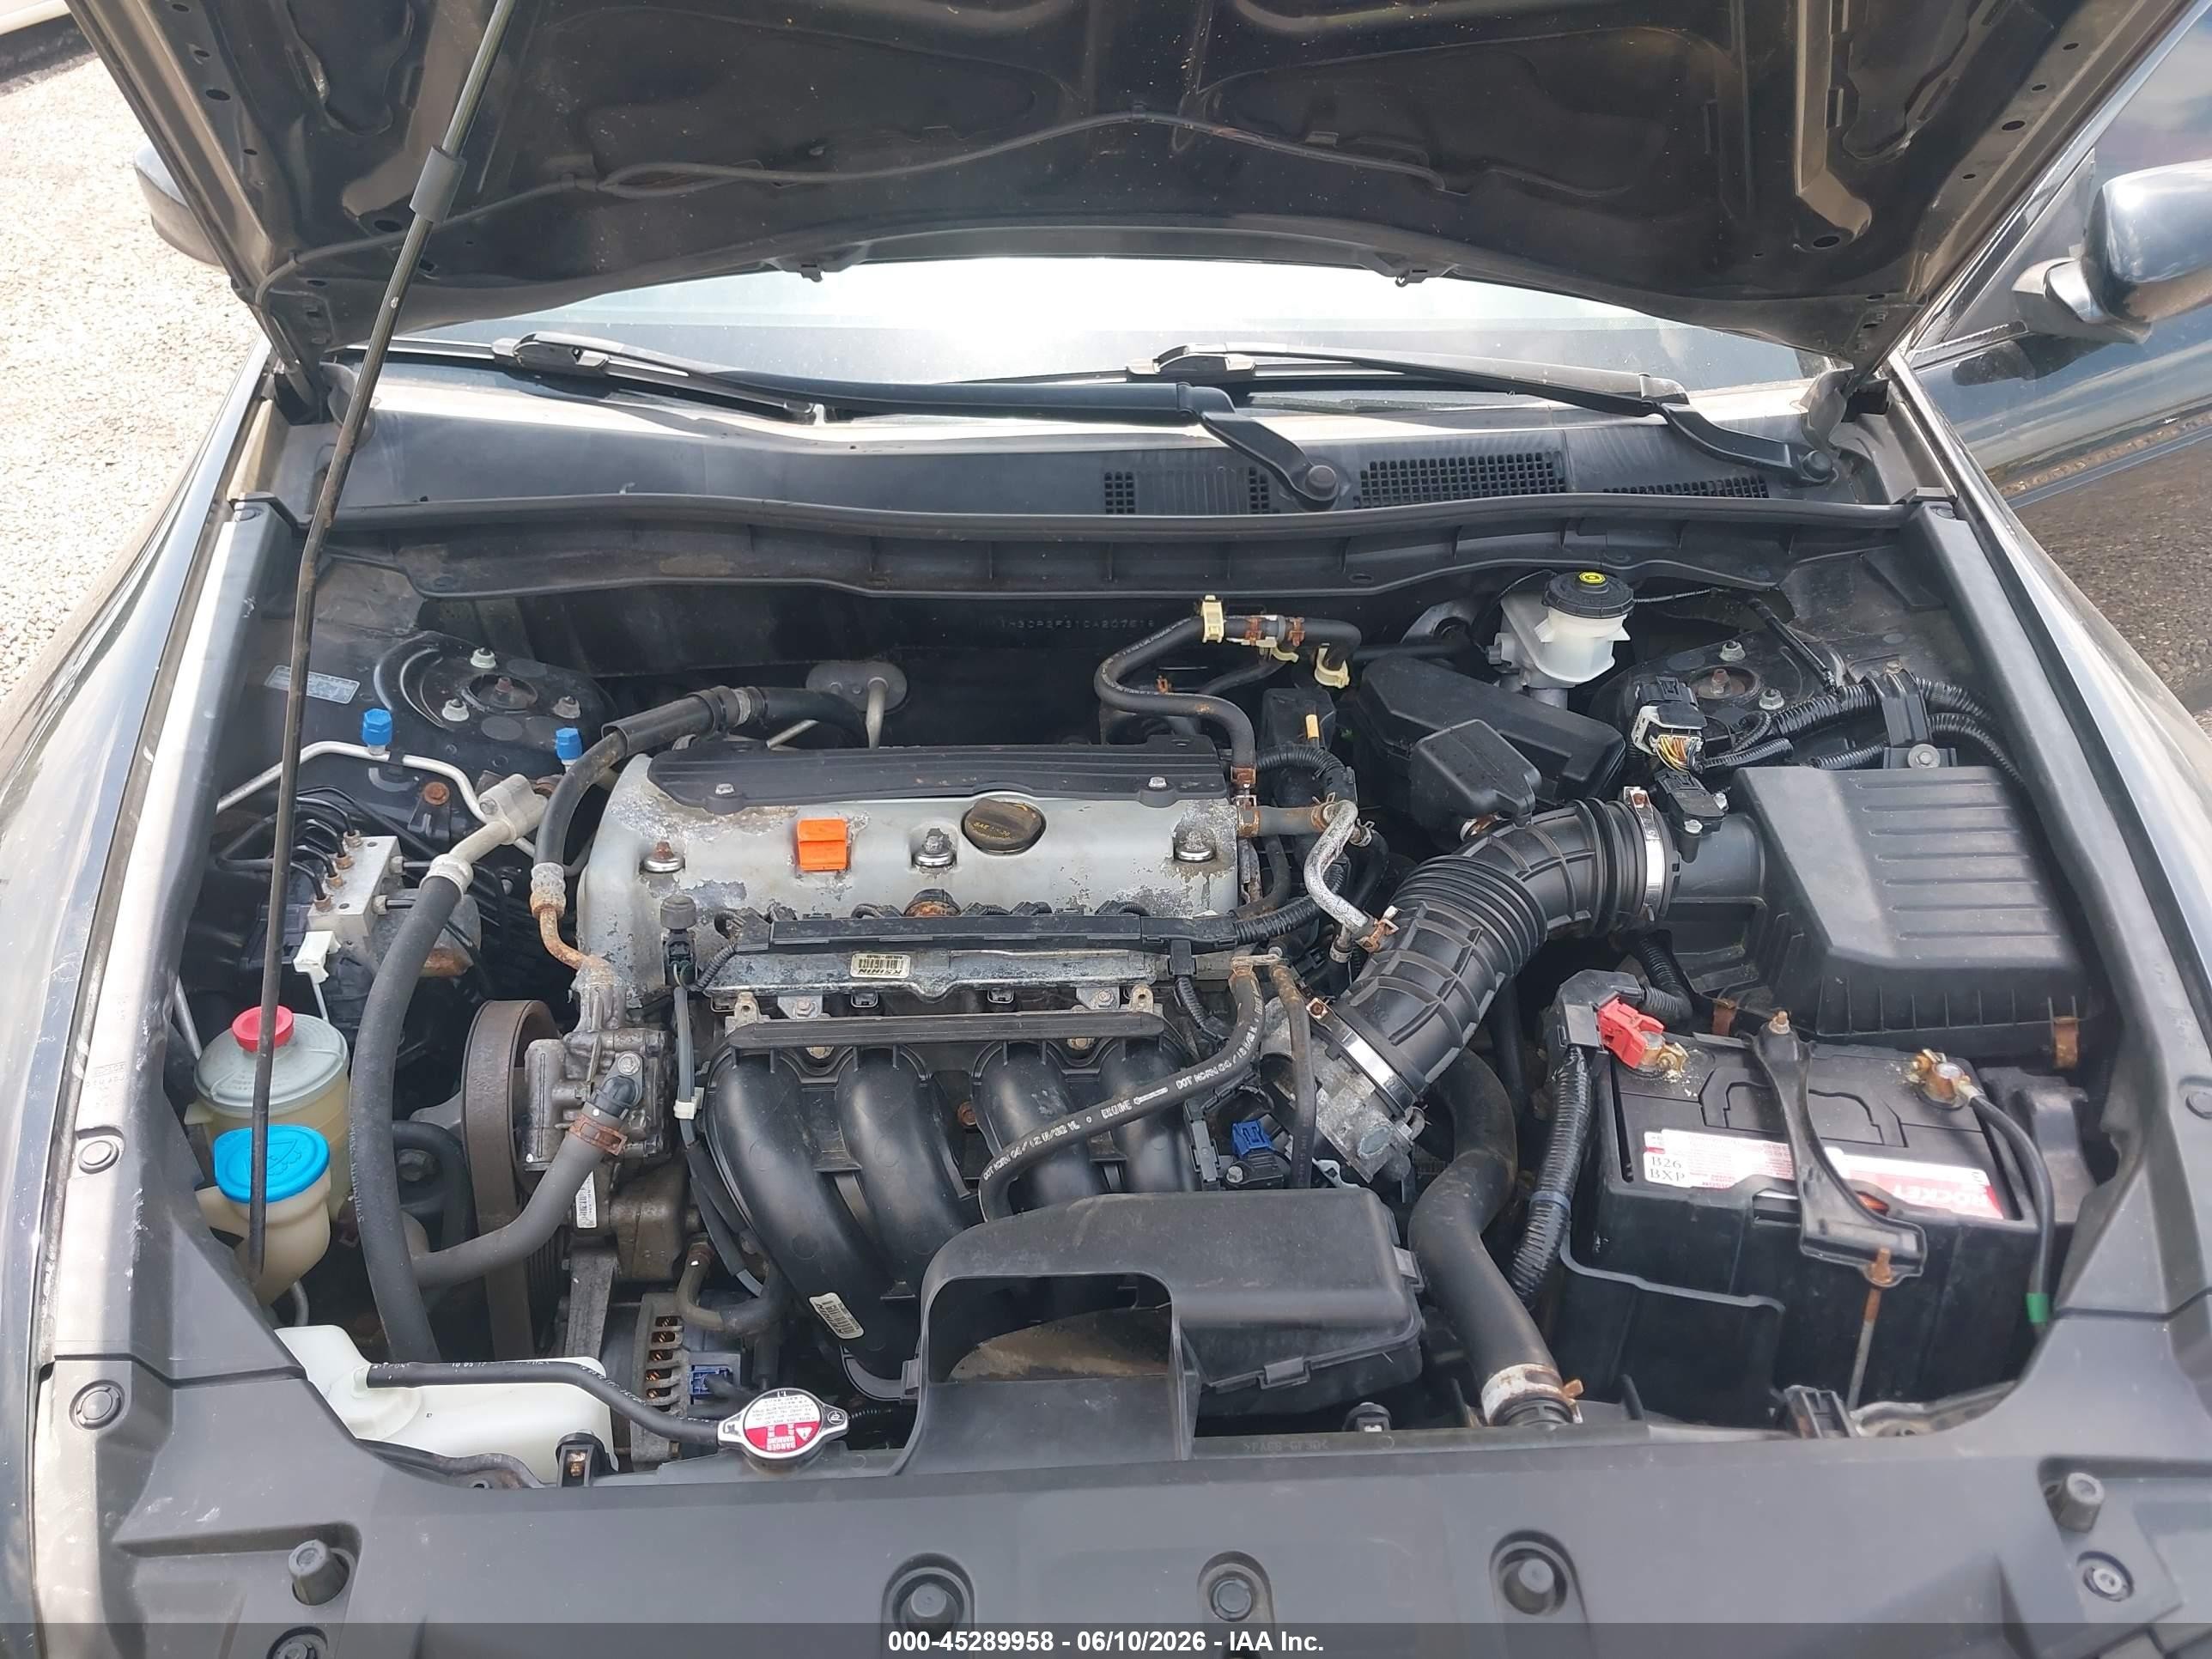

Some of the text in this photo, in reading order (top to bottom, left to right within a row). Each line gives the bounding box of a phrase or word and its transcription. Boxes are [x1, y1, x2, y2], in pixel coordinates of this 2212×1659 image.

[1650, 1156, 1682, 1169] B26
[1650, 1168, 1686, 1182] BXP
[1891, 1184, 1989, 1208] ROCKET
[766, 1442, 797, 1451] DANGER
